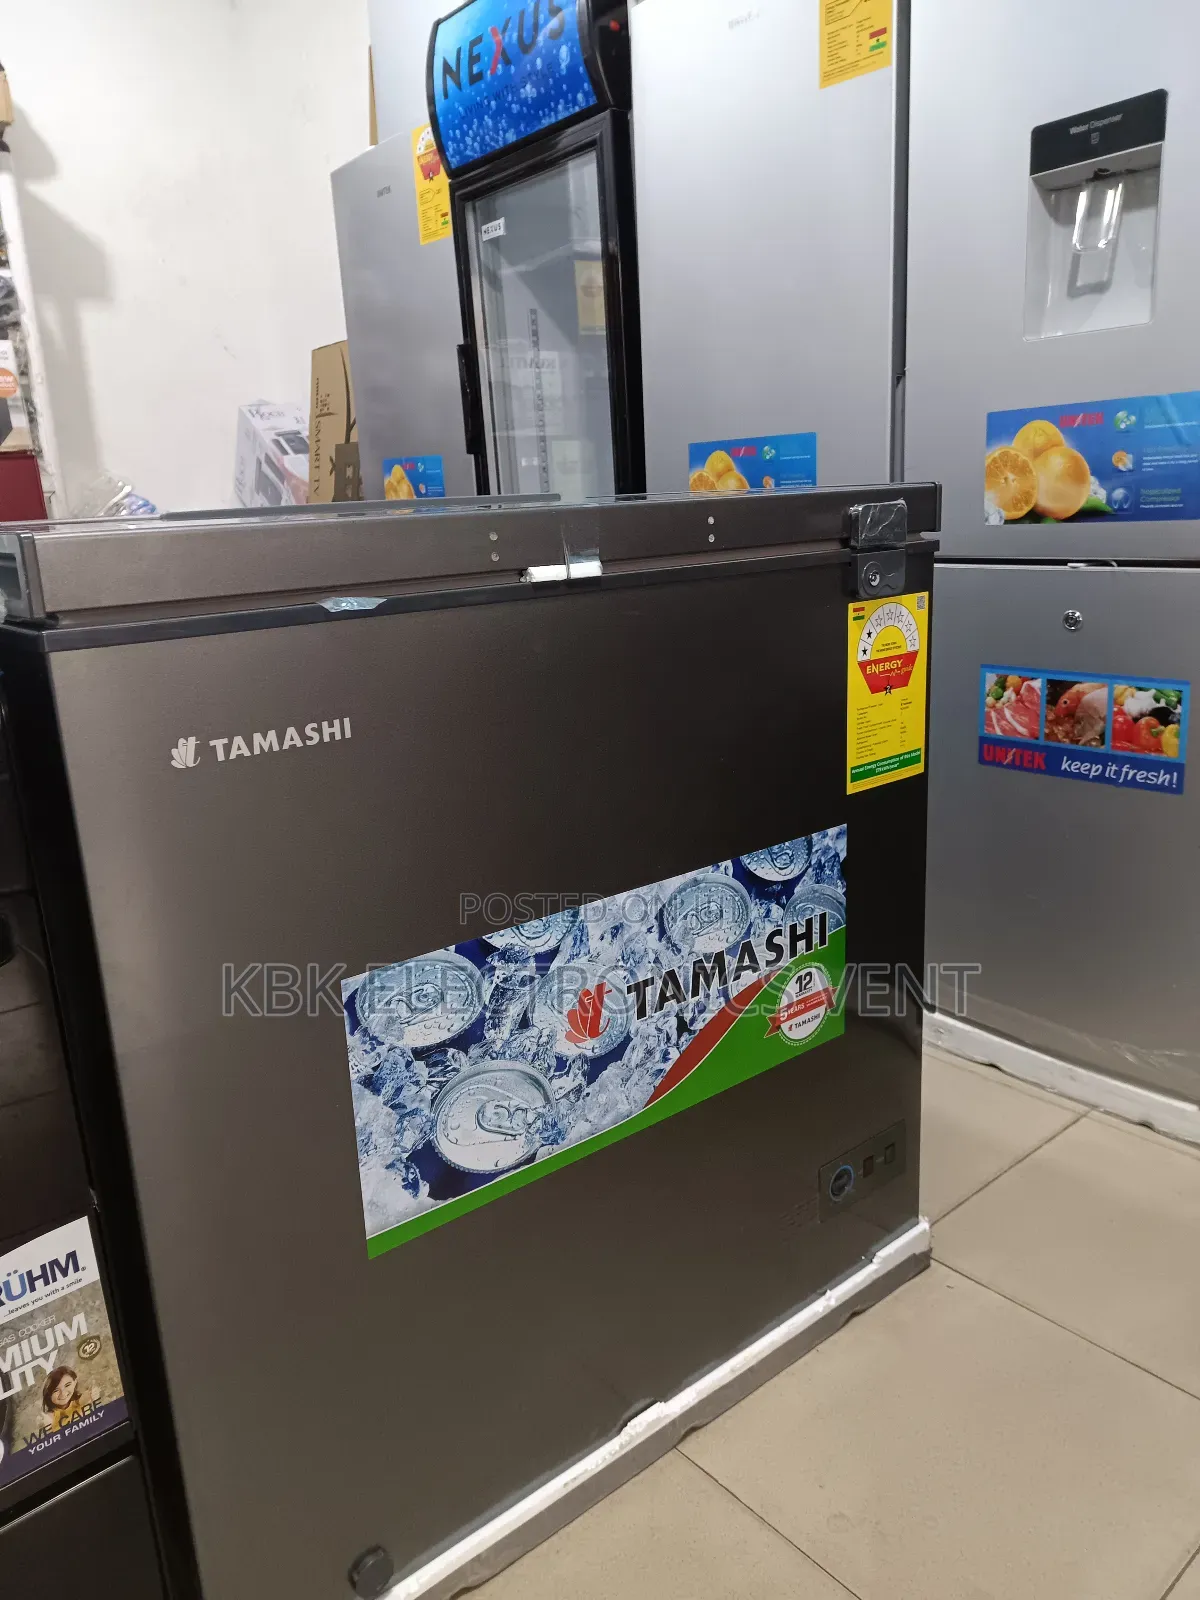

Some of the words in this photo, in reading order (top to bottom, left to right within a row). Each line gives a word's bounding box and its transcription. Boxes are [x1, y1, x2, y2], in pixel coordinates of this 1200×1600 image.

[442, 0, 566, 100] NEXUS
[1069, 123, 1089, 135] Water
[1089, 113, 1123, 129] Dispenser
[483, 222, 501, 235] NEXUS
[866, 658, 904, 675] ENERGY
[208, 717, 352, 762] TAMASHI
[1060, 755, 1103, 778] keep
[1104, 762, 1118, 779] it
[1118, 764, 1178, 788] fresh!
[625, 910, 829, 1021] TAMASHI
[795, 971, 813, 993] 12
[779, 1007, 788, 1020] 5
[794, 1013, 821, 1029] TAMASHI
[31, 1295, 43, 1305] you
[44, 1287, 60, 1298] with
[66, 1278, 83, 1289] smile
[18, 1315, 56, 1337] COOKER
[22, 1423, 53, 1445] WE
[58, 1396, 103, 1428] CARE
[28, 1433, 62, 1455] YOUR
[64, 1409, 105, 1437] FAMILY
